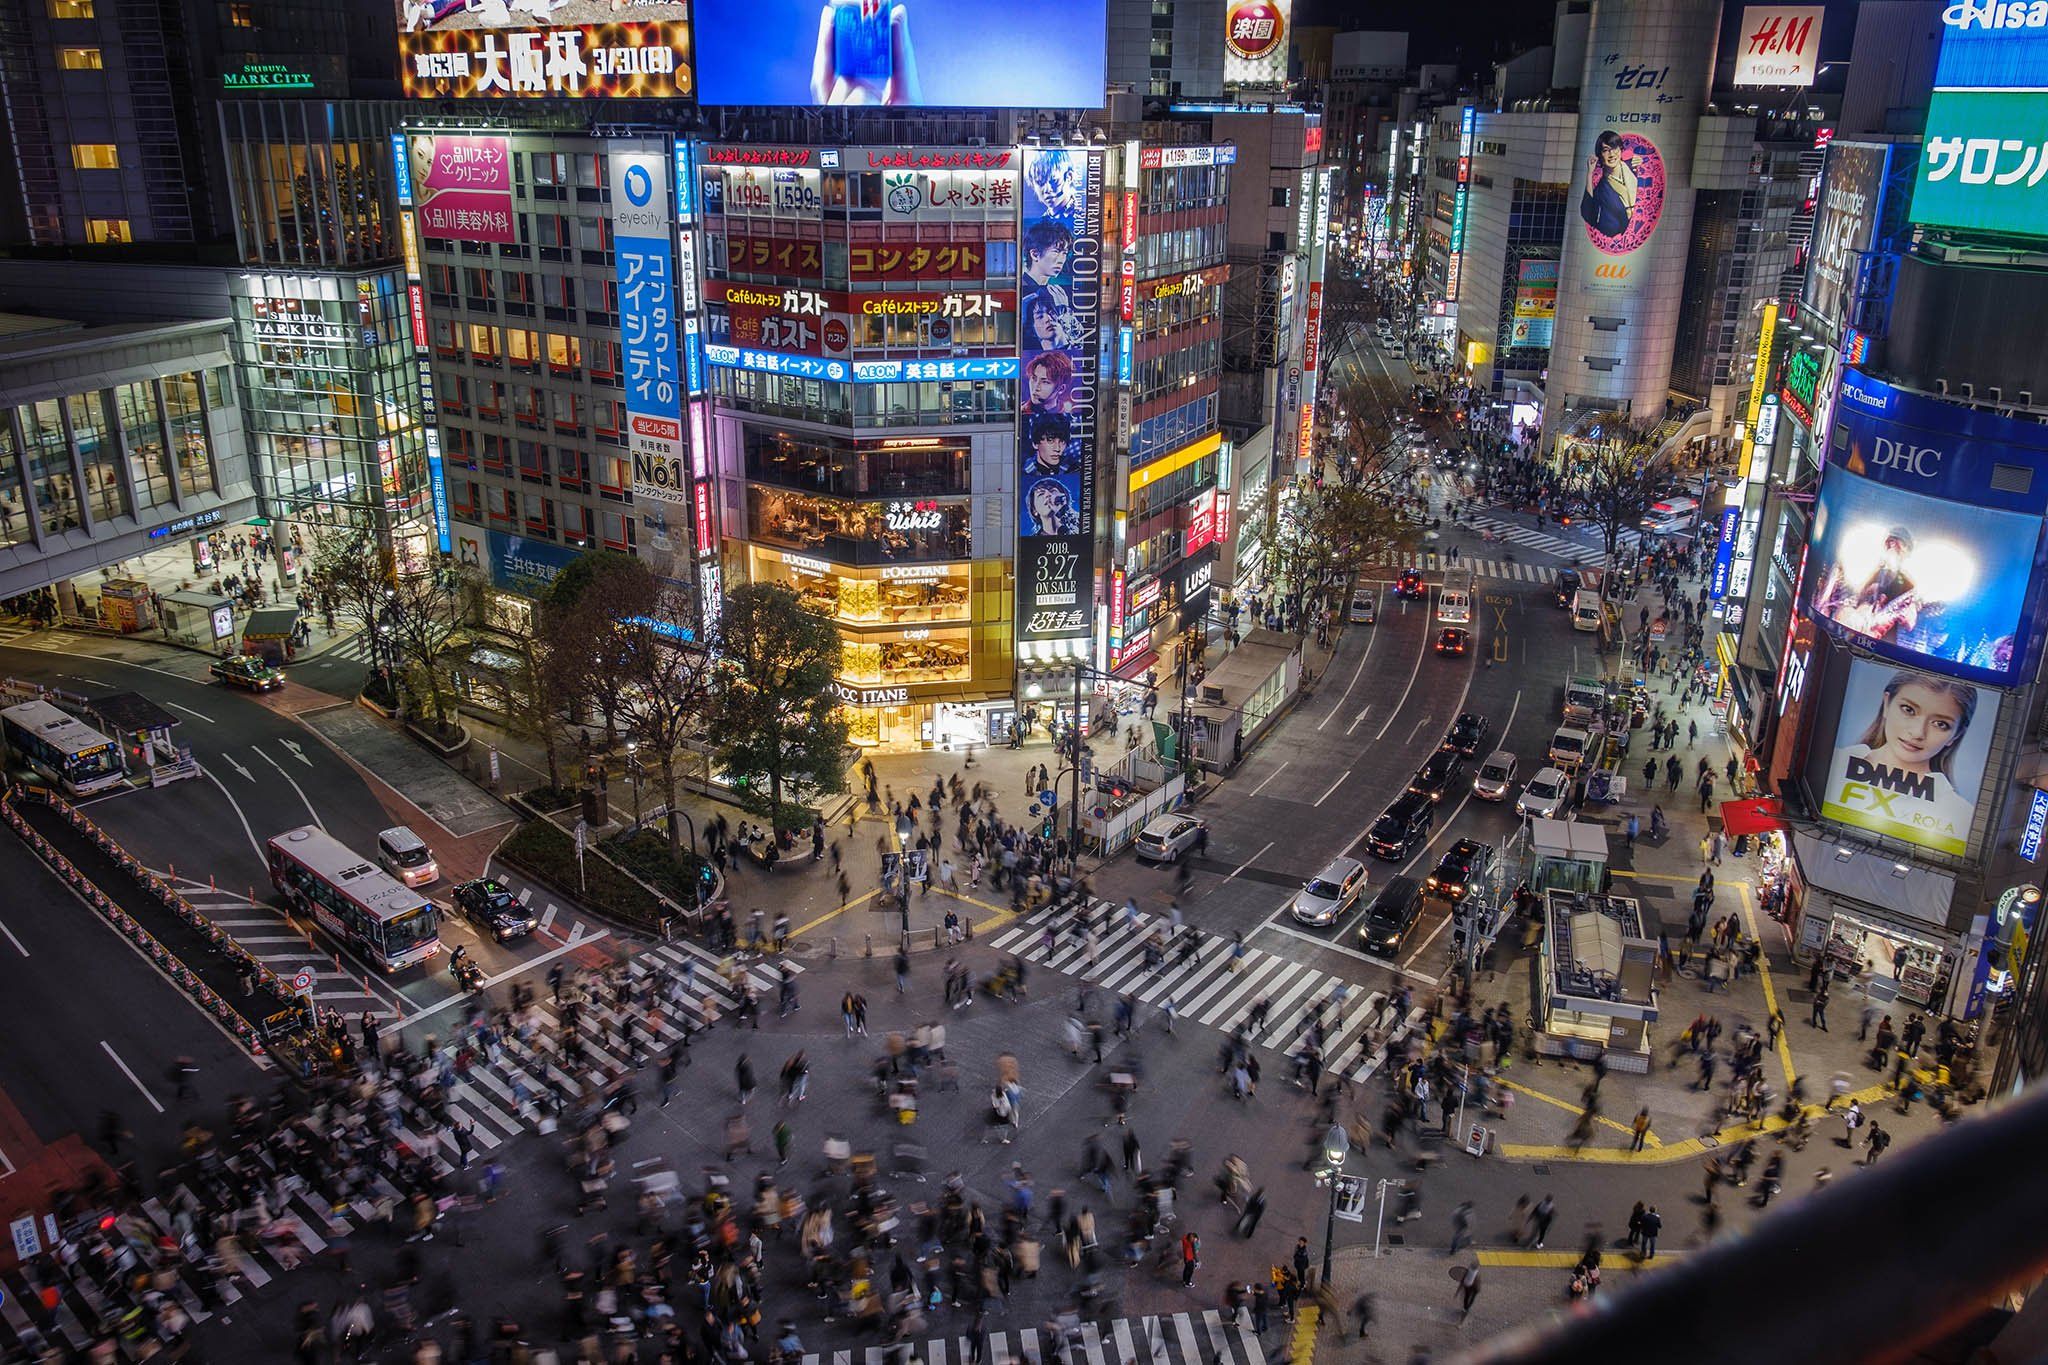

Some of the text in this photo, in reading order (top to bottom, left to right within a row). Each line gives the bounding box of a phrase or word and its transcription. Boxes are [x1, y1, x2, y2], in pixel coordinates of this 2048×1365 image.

[1232, 17, 1275, 39] 楽園
[1749, 16, 1814, 56] H&M
[244, 65, 287, 73] SHIBUYA
[474, 31, 587, 92] 大阪杯
[592, 46, 673, 75] 3/31(日)
[1751, 65, 1786, 76] 150m
[223, 73, 312, 84] MARK CITY
[1656, 93, 1684, 104] キュー
[1605, 112, 1662, 124] au ゼロ学割
[453, 147, 503, 164] 品川スキン
[708, 147, 812, 167] しゃぶしゃぶバイキング
[867, 151, 1012, 169] しゃぶしゃぶバイキング
[455, 167, 499, 183] クリニック
[704, 180, 722, 198] 9F
[929, 179, 1013, 207] しゃぶ葉
[1087, 155, 1101, 236] BULLET TRAIN
[433, 209, 510, 233] 品川美容外科
[619, 209, 662, 228] eyecity
[1314, 173, 1328, 248] BIC CAMERA
[728, 240, 821, 268] プライス
[851, 247, 981, 273] コンタクト
[1447, 257, 1459, 297] HOOTERS
[1594, 262, 1632, 280] au
[1182, 273, 1204, 297] ガスト
[783, 290, 829, 316] ガスト
[941, 294, 1002, 318] ガスト
[1123, 286, 1133, 315] ガスト
[270, 311, 324, 322] SHIBUYA
[621, 252, 651, 401] アイシティ
[710, 314, 729, 335] 7F
[735, 317, 759, 332] Café
[649, 255, 673, 404] コンタクトの
[761, 317, 816, 350] ガスト
[1070, 236, 1099, 440] GOLDEN EPOCH
[1306, 317, 1318, 362] TaxFree
[710, 349, 736, 363] AEON
[743, 351, 824, 376] 英会話イーオン
[858, 361, 1017, 379] AEON 英会話イーオン
[1853, 388, 1888, 409] Channel
[637, 418, 676, 437] 当ビル5階
[640, 439, 671, 453] 利用者数
[1871, 436, 1942, 478] DHC
[1083, 455, 1093, 486] SAITAMA
[634, 484, 683, 502] コンタクトショップ
[1083, 487, 1092, 510] SUPER
[890, 501, 912, 514] 渋谷
[1724, 513, 1736, 543] MIZUHO
[1046, 542, 1070, 555] 2019.
[781, 553, 831, 573] L'OCCITANE
[882, 566, 949, 578] L'OCCITANE
[1036, 554, 1079, 582] 3.27
[1036, 580, 1077, 594] ON SALE
[1185, 561, 1212, 596] LUSH
[1856, 636, 1877, 650] DHC
[1844, 755, 1935, 802] DMM
[1839, 781, 1899, 818] FX
[1912, 812, 1956, 834] ROLA
